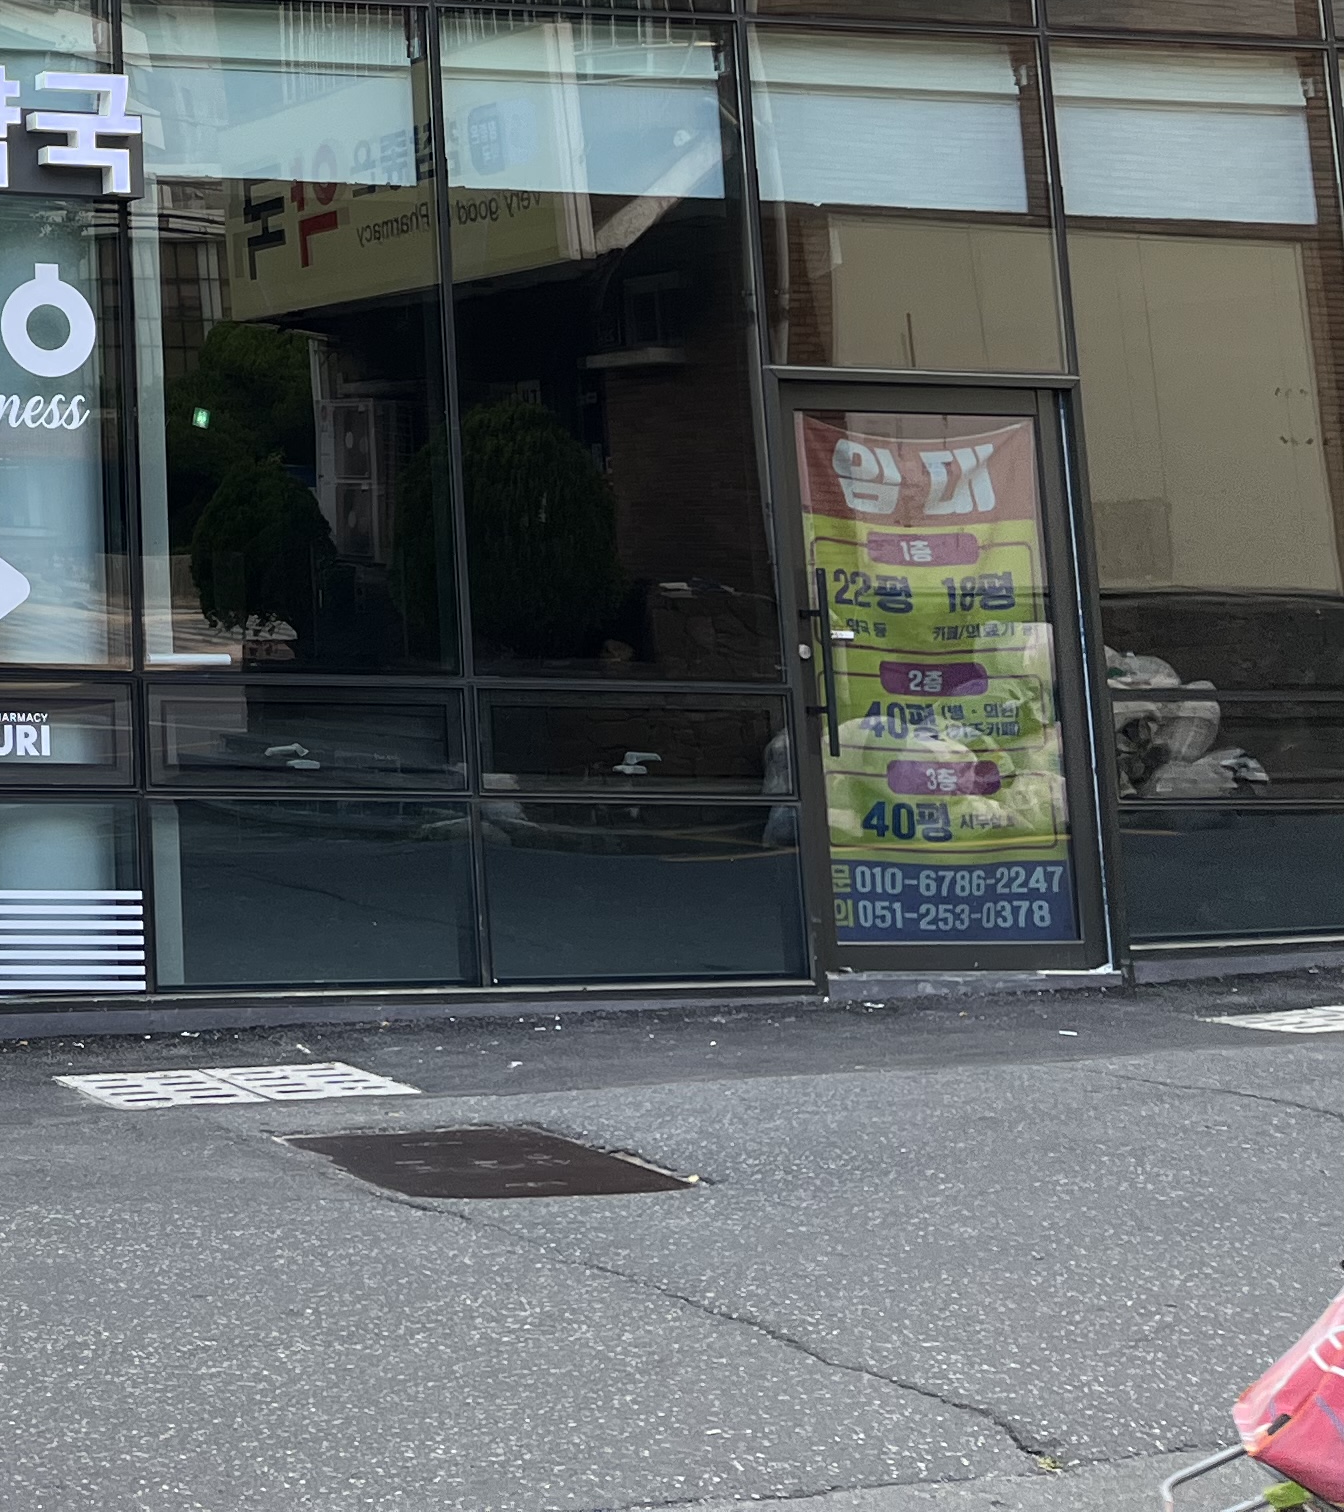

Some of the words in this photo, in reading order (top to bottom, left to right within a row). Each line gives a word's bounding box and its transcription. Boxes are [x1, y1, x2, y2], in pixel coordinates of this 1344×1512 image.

[832, 438, 996, 515] 임대
[899, 540, 933, 562] 1층
[833, 568, 913, 614] 22평
[941, 570, 1016, 613] 18평
[908, 670, 943, 692] 2층
[926, 768, 957, 791] 3층
[862, 801, 953, 842] 40평
[854, 865, 1064, 898] 010-6786-2247
[857, 899, 1052, 931] 051-253-0378
